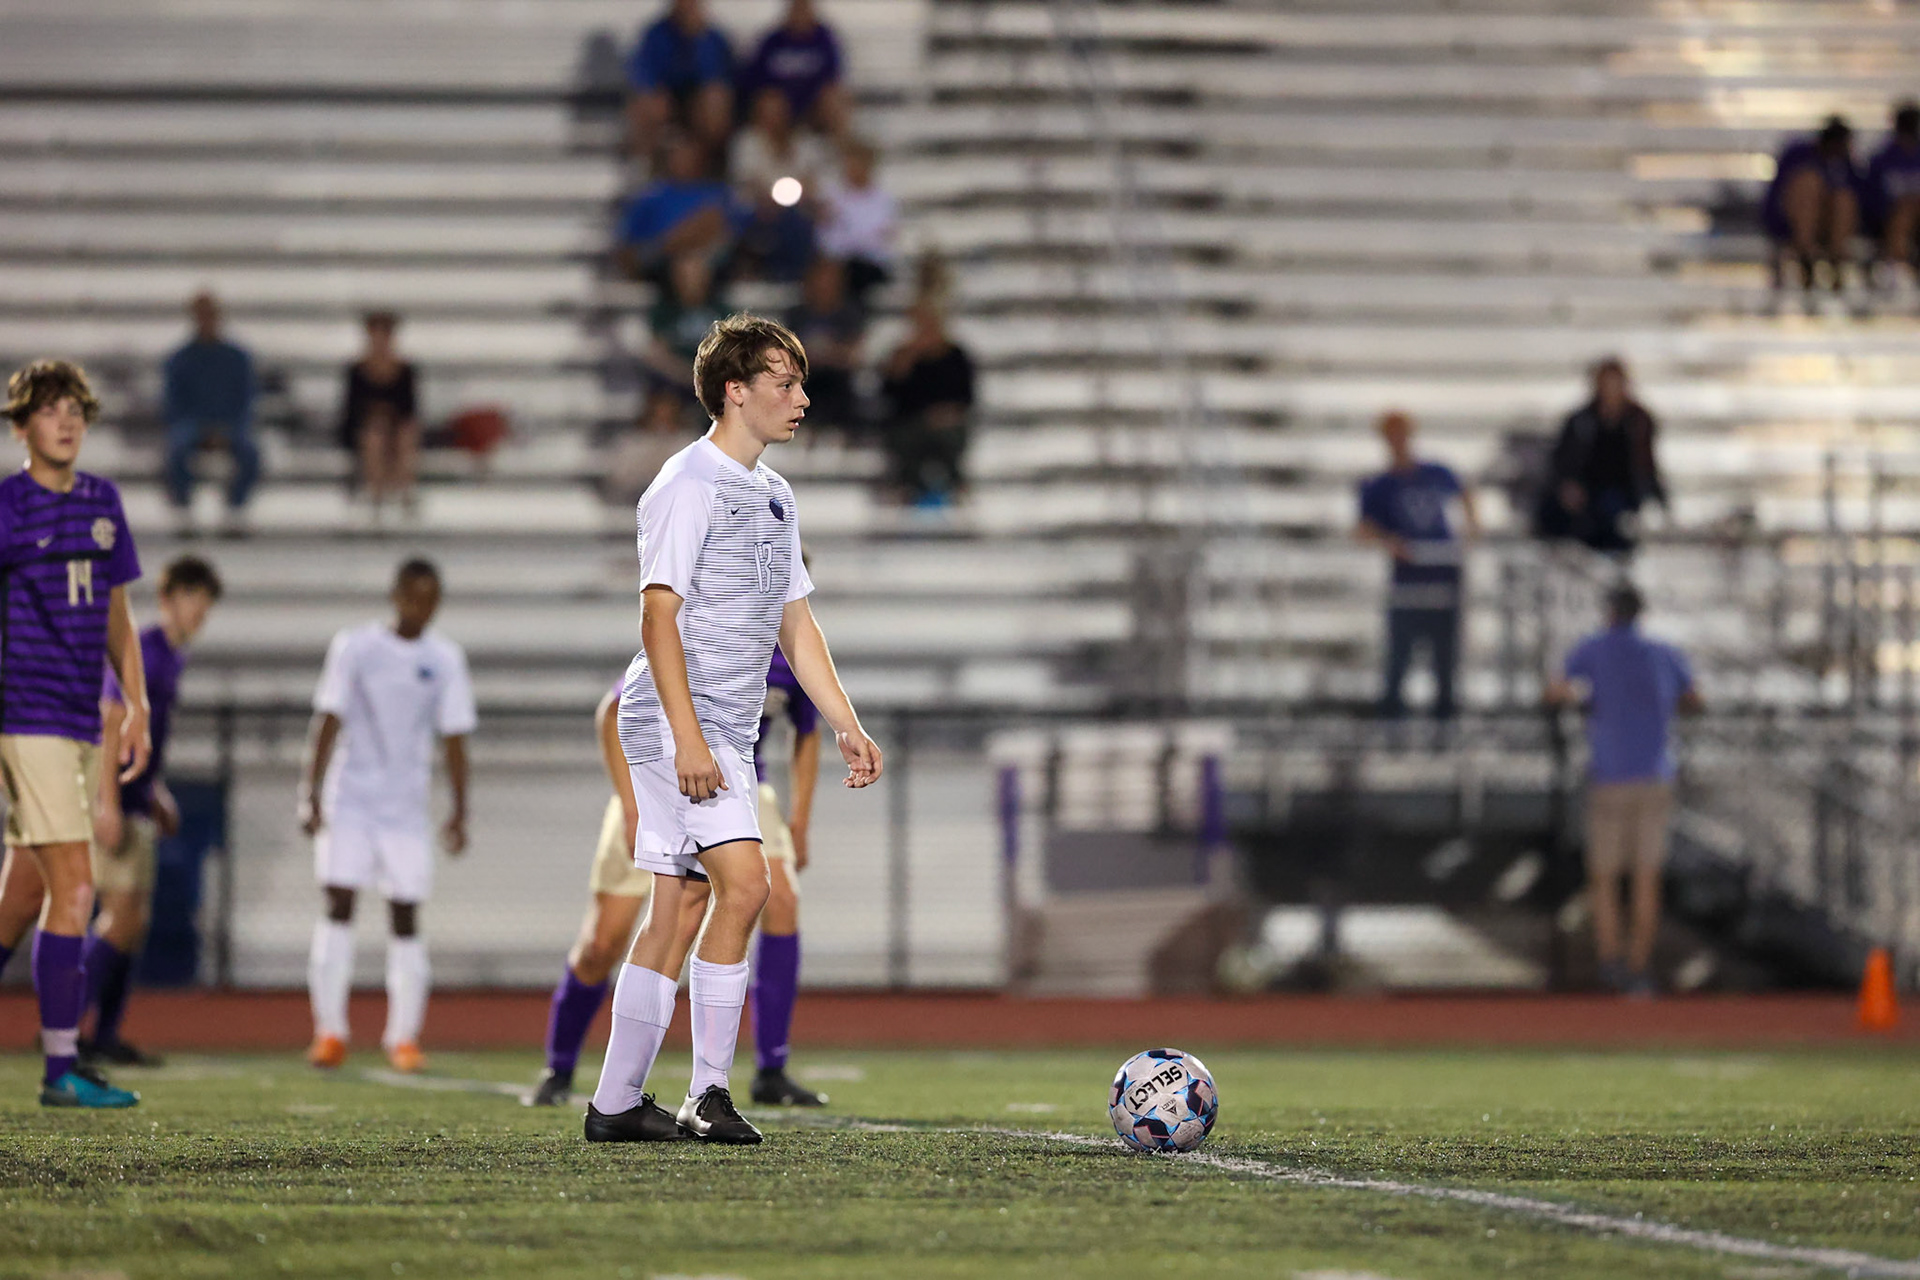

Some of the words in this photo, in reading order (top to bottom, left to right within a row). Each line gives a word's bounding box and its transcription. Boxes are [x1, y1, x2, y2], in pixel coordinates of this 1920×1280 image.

[754, 541, 773, 593] 13
[1129, 1065, 1183, 1111] SELECT
[1161, 1098, 1177, 1111] SELECT
